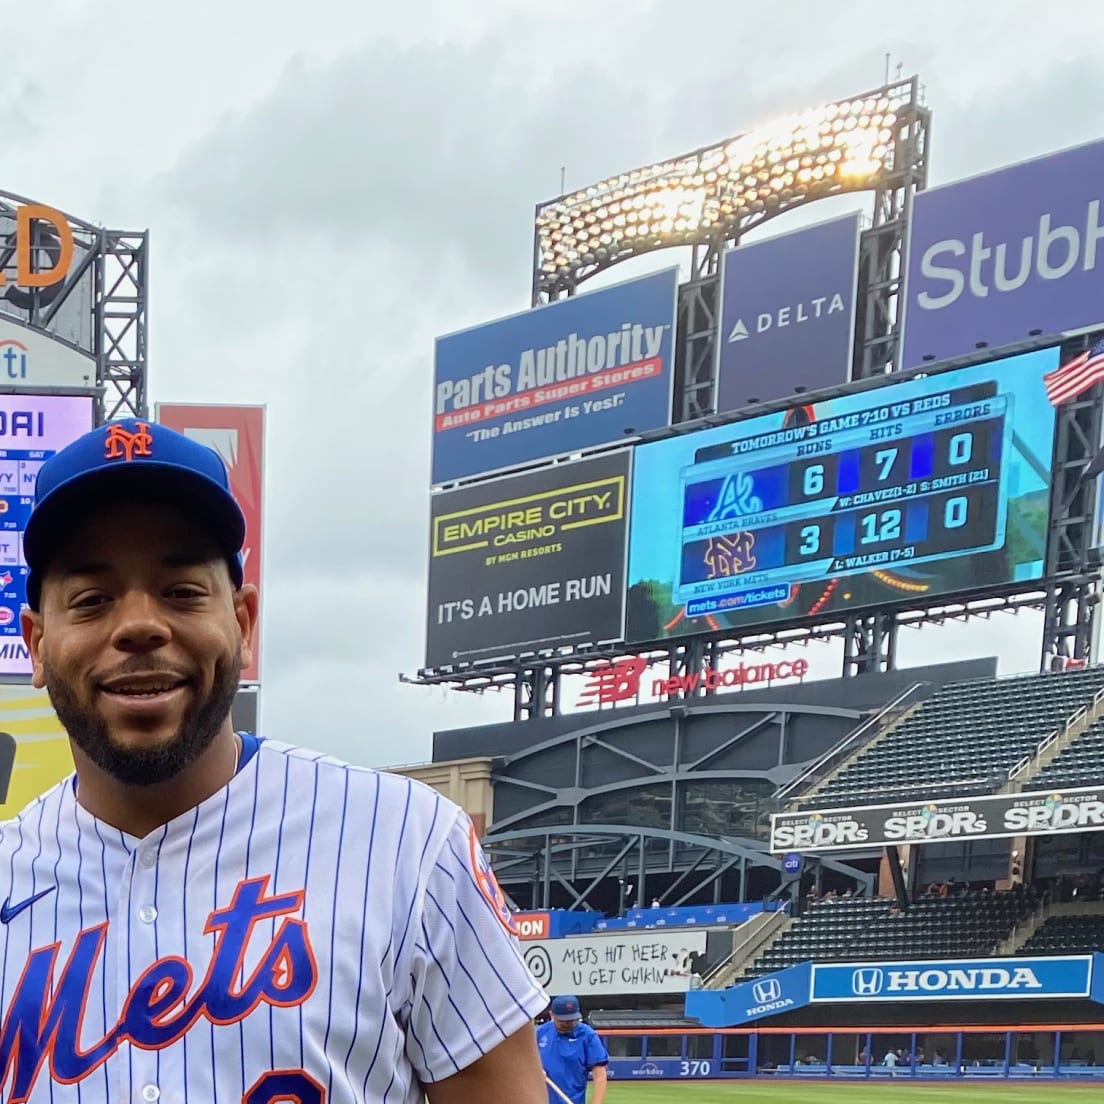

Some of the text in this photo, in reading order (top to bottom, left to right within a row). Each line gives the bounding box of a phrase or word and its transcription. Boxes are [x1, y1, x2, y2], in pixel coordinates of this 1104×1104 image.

[757, 293, 845, 333] DELTA
[436, 323, 664, 414] Parts Authority
[441, 364, 655, 428] Auto Parts Super Stores
[503, 409, 562, 435] Answer
[564, 404, 580, 419] Is
[731, 394, 951, 454] TOMORROW'S GAME 7:10 VS REDS
[797, 404, 991, 457] RUNS HITS ERRORS
[803, 433, 973, 495] 6 7 0
[932, 473, 967, 489] SMITH
[443, 491, 612, 542] EMPIRE CITY
[697, 519, 741, 536] ATLANTA
[800, 496, 968, 555] 3 12 0
[494, 525, 556, 546] CASINO
[486, 543, 562, 565] BY MGM RESORTS
[845, 551, 889, 567] WALKER
[694, 573, 769, 593] NEW YORK METS
[438, 574, 612, 624] IT'S A HOME RUN
[689, 588, 786, 613] mets.com/tickets
[652, 658, 809, 697] new balance
[1004, 801, 1104, 832] SPDR
[516, 920, 544, 936] ION
[562, 943, 669, 965] METS HIT HEER
[572, 967, 666, 986] U GET CHIKIN
[887, 968, 1043, 992] HONDA
[746, 998, 794, 1016] HONDA
[680, 1061, 711, 1076] 370
